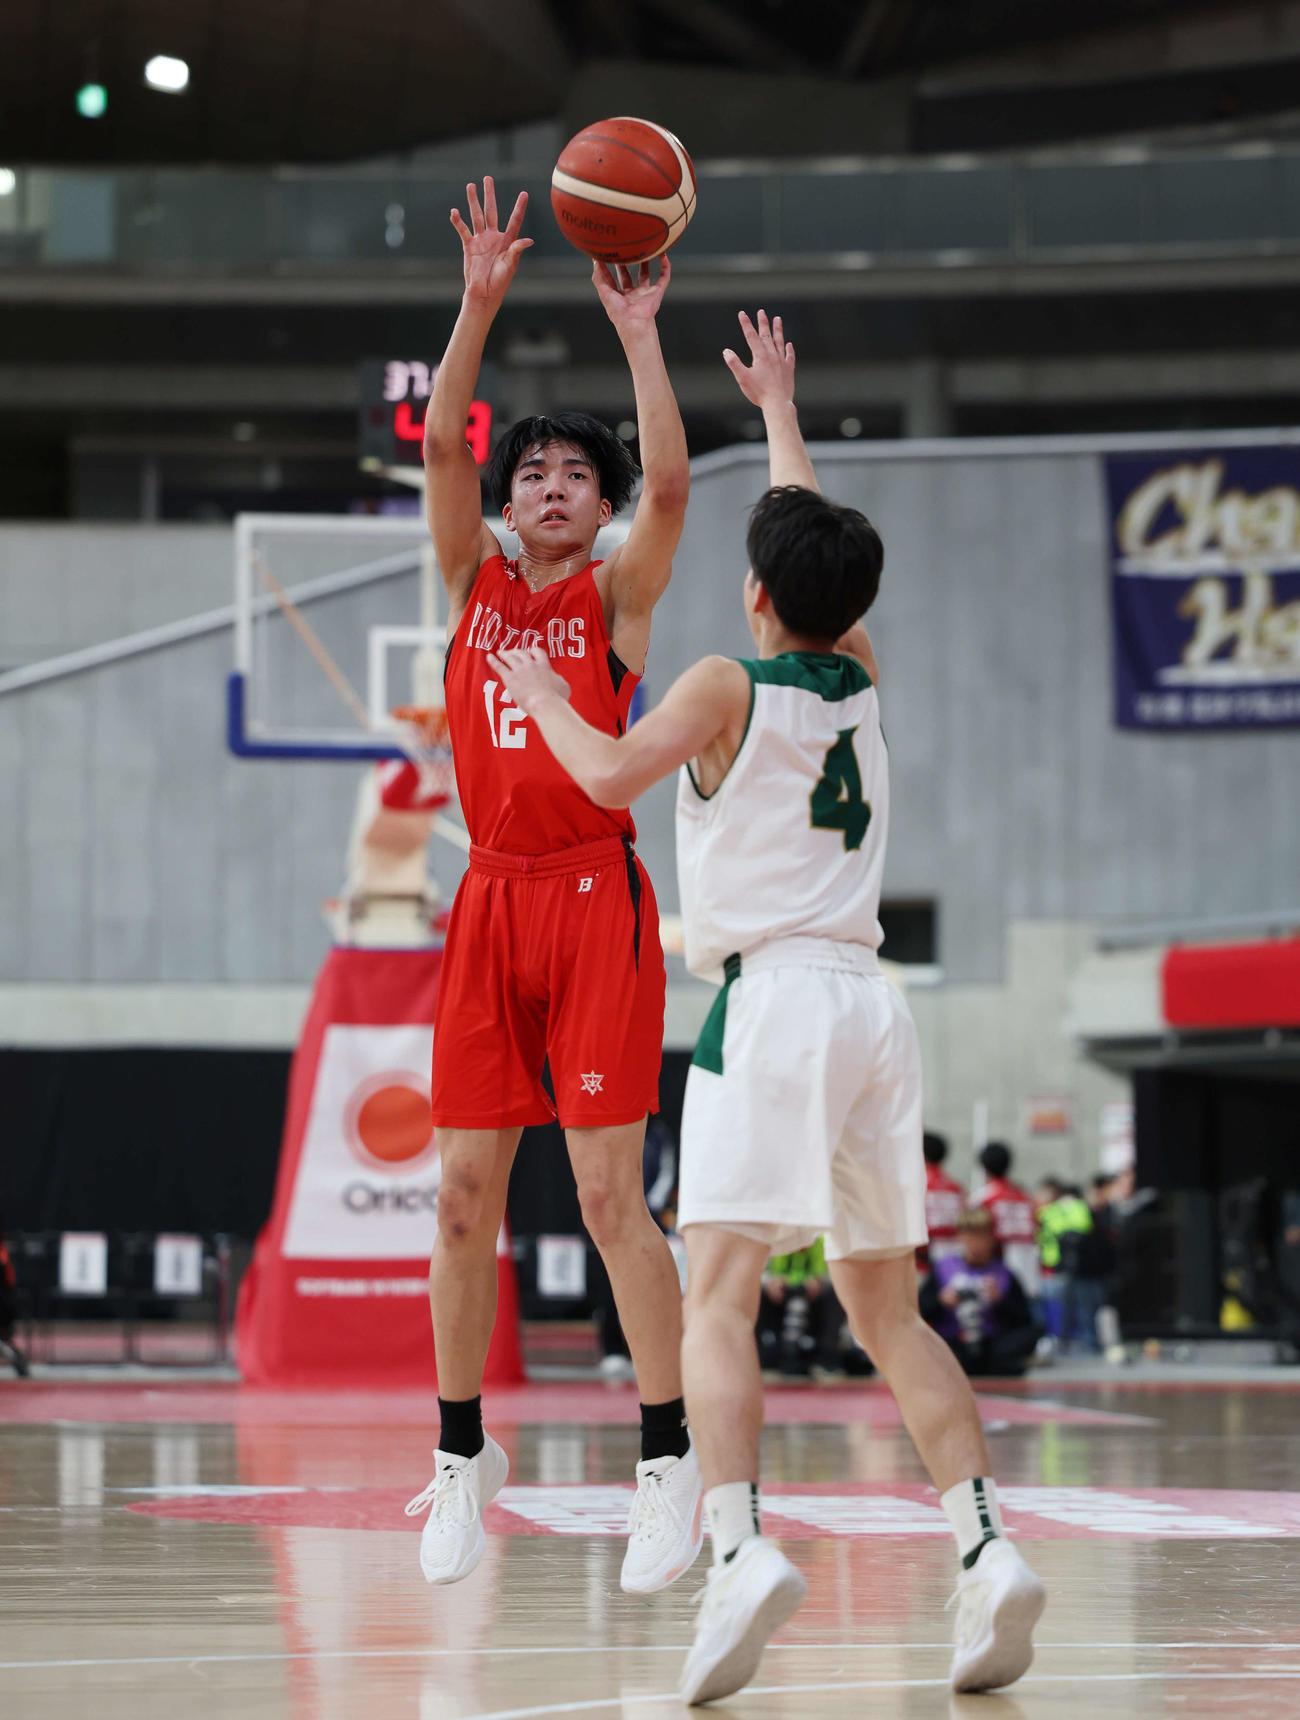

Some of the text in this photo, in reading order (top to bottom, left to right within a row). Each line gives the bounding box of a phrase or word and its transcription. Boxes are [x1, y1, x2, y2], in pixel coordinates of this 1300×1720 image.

[561, 208, 617, 236] molten
[482, 679, 528, 749] 12
[809, 724, 873, 853] 4
